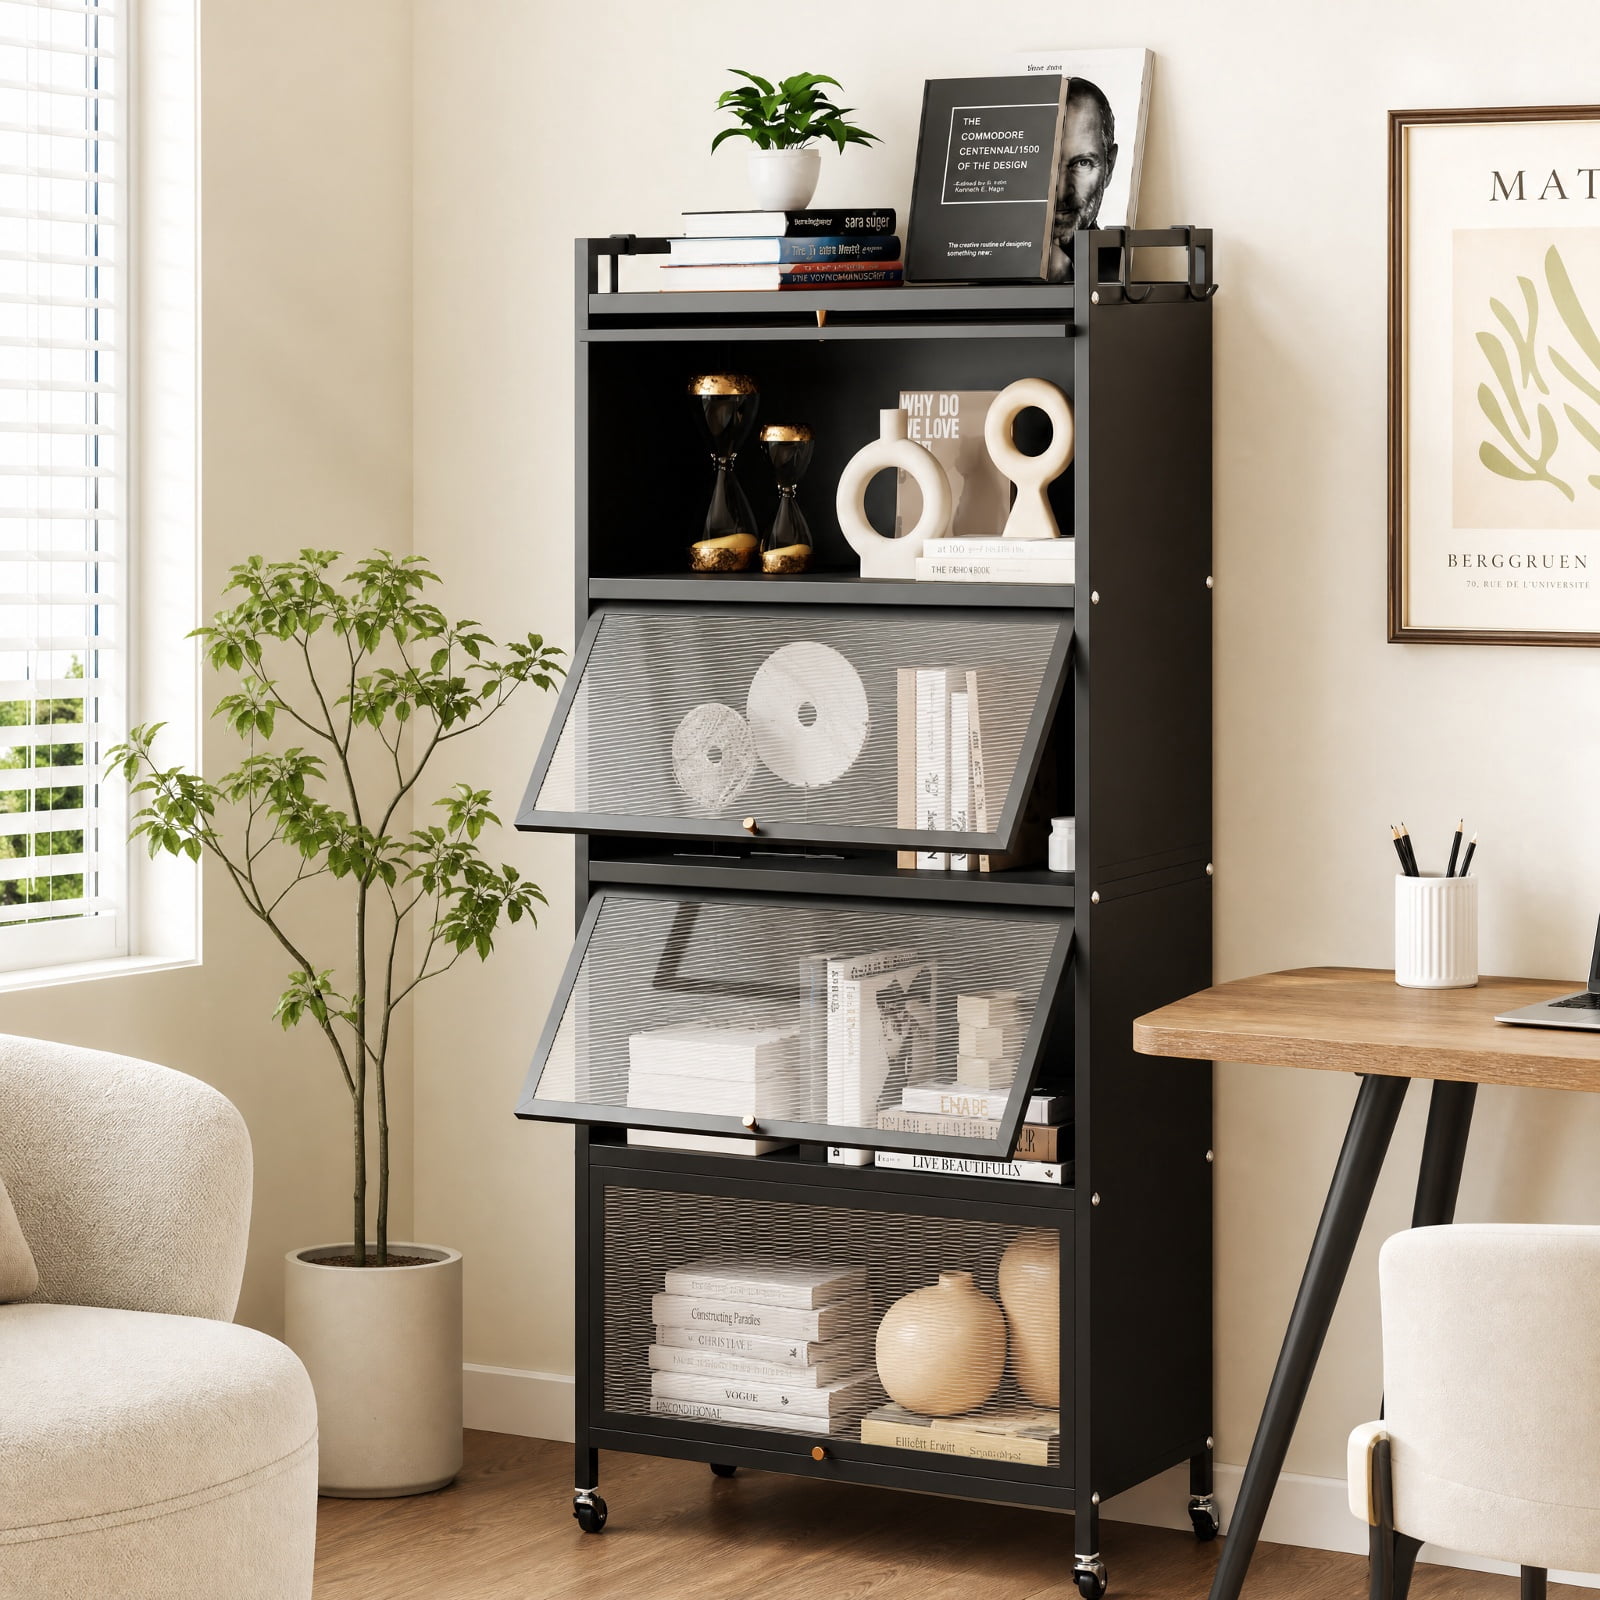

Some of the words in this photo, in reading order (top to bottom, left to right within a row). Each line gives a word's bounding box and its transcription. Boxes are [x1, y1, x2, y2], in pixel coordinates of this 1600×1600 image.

[963, 117, 981, 126] THE
[961, 130, 1024, 141] COMMODORE
[957, 162, 971, 171] OF
[973, 161, 990, 170] THE
[993, 160, 1028, 170] DESIGN
[845, 216, 864, 229] sara
[901, 394, 934, 416] WHY
[939, 393, 959, 417] DO
[925, 417, 960, 439] LOVE
[1447, 553, 1588, 569] BERGGRUEN
[931, 565, 946, 574] THE
[1483, 580, 1503, 588] RUE
[1506, 580, 1518, 588] DE
[912, 1155, 940, 1170] LIVE
[724, 1390, 759, 1402] VOGUE
[930, 1440, 955, 1453] Erwitt
